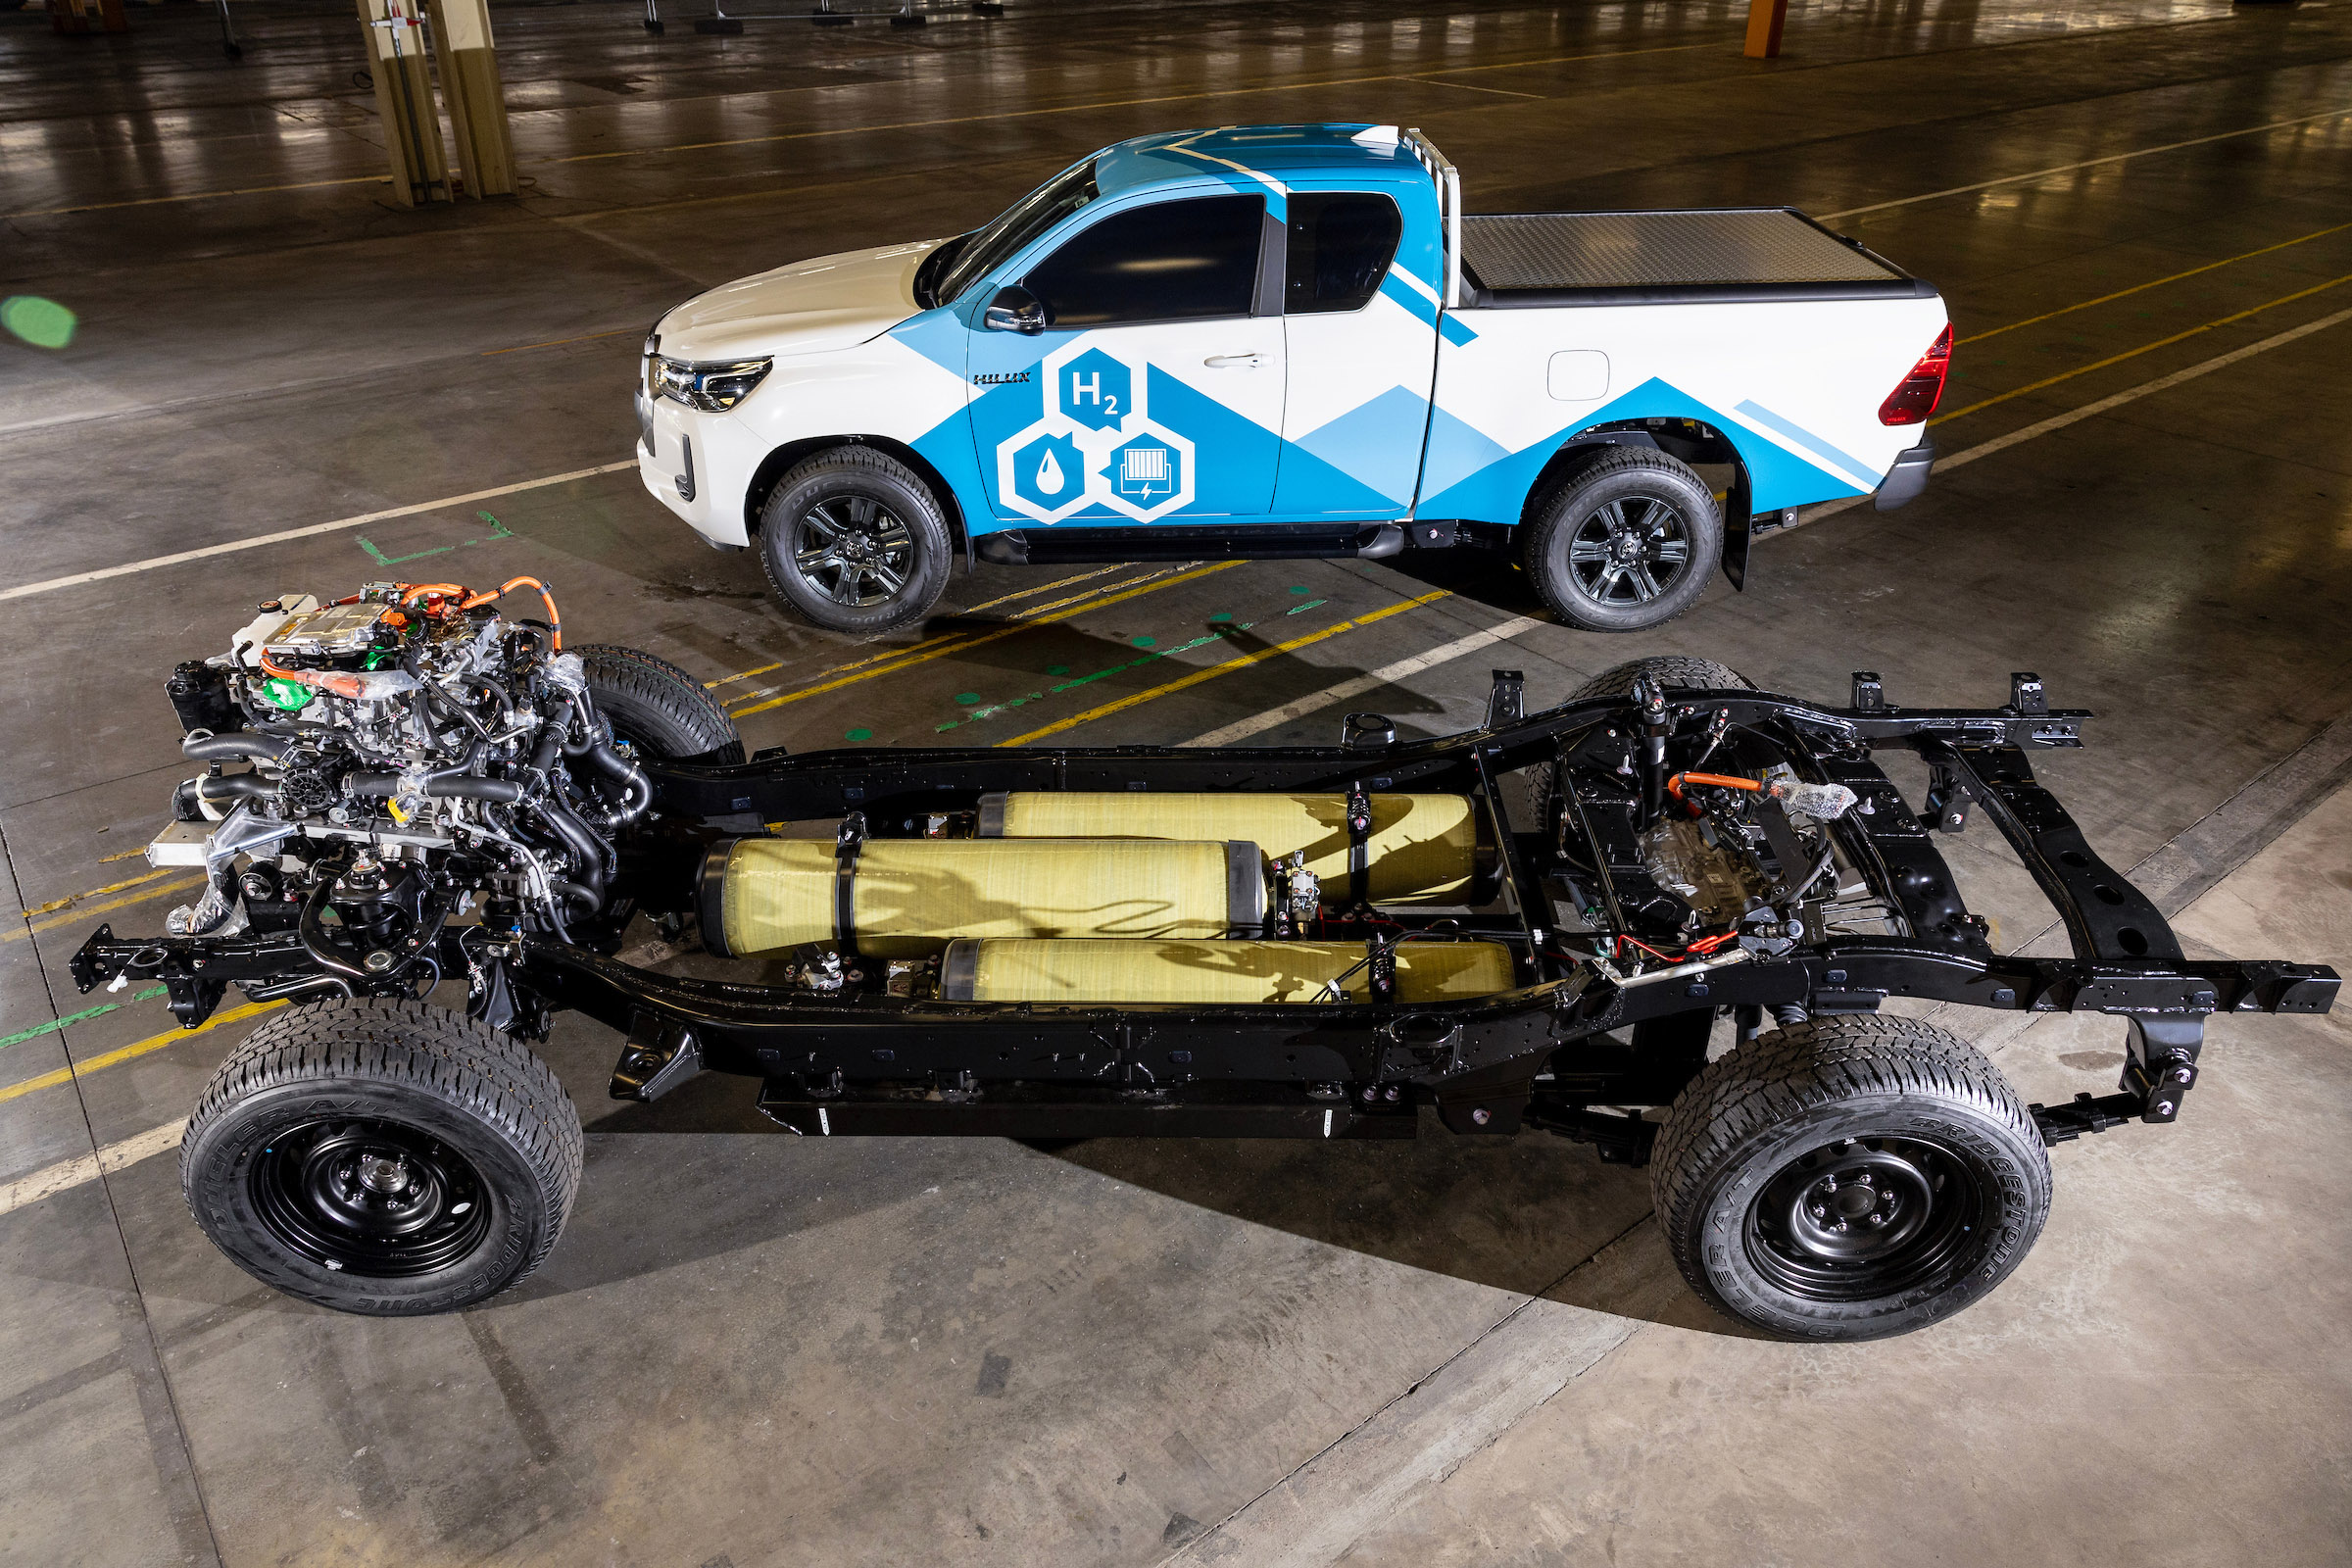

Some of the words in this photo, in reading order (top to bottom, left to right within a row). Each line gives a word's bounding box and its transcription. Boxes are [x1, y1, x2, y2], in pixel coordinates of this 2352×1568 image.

[974, 372, 1031, 385] HILUX
[1073, 371, 1118, 416] H2
[205, 1106, 290, 1233] DUELER
[1712, 1167, 1754, 1234] A/T
[1909, 1116, 2027, 1281] BRIDGESTONE
[353, 1194, 525, 1311] BRIDGESTONE
[1709, 1243, 1846, 1338] DUELER
